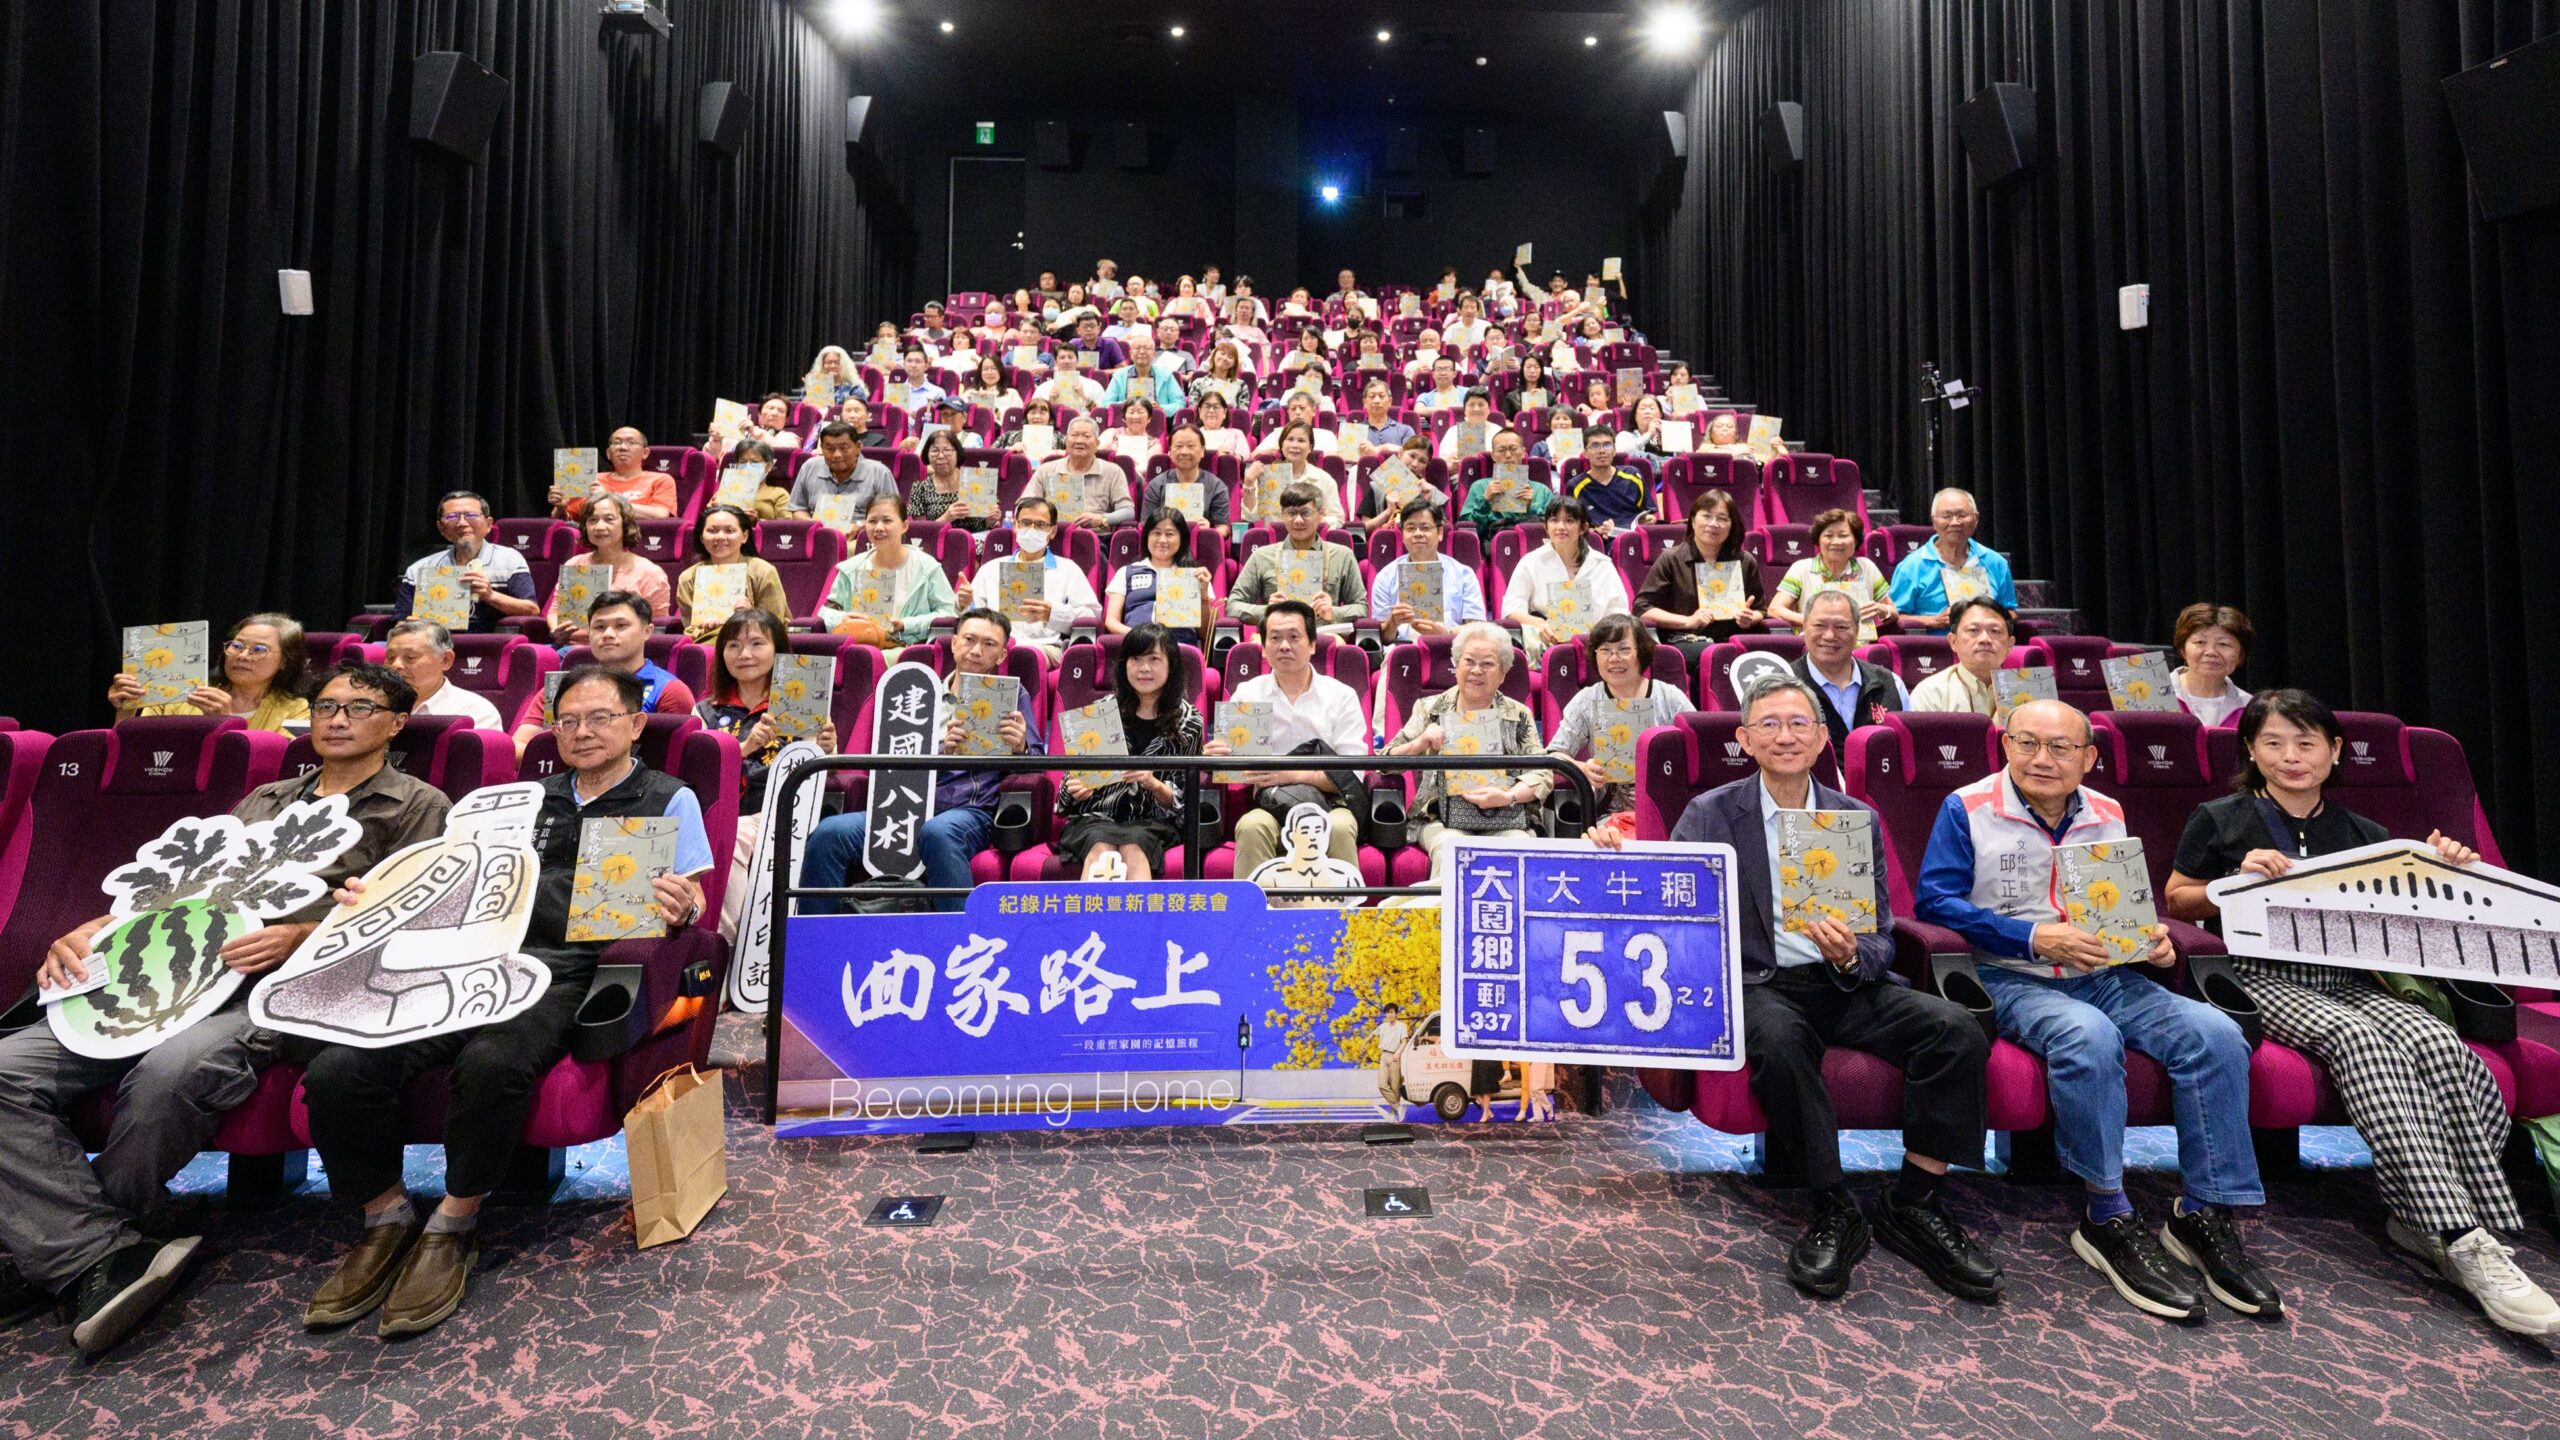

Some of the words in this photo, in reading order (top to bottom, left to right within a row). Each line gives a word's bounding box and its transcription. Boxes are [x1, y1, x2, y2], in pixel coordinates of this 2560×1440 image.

[994, 543, 1003, 552] 10
[1121, 545, 1128, 554] 9
[1381, 545, 1387, 554] 7
[1504, 546, 1510, 556] 6
[1628, 546, 1634, 555] 5
[1752, 546, 1758, 555] 4
[1073, 667, 1082, 679] 9
[1239, 664, 1248, 676] 8
[1401, 665, 1409, 677] 7
[1560, 665, 1568, 677] 6
[1723, 664, 1730, 675] 5
[58, 763, 79, 776] 13
[537, 760, 554, 773] 11
[1664, 760, 1672, 775] 6
[1881, 758, 1889, 773] 5
[2097, 757, 2104, 771] 4
[2016, 840, 2031, 893] 文化局長
[1546, 870, 1697, 908] 大牛稠
[998, 892, 1229, 915] 紀錄片首映暨新書發表會
[1470, 866, 1513, 970] 大園鄉
[1558, 930, 1674, 1033] 53
[1477, 981, 1506, 1009] 郵
[1470, 1011, 1513, 1032] 337
[829, 1075, 1072, 1127] Becoming
[1096, 1071, 1234, 1114] Home
